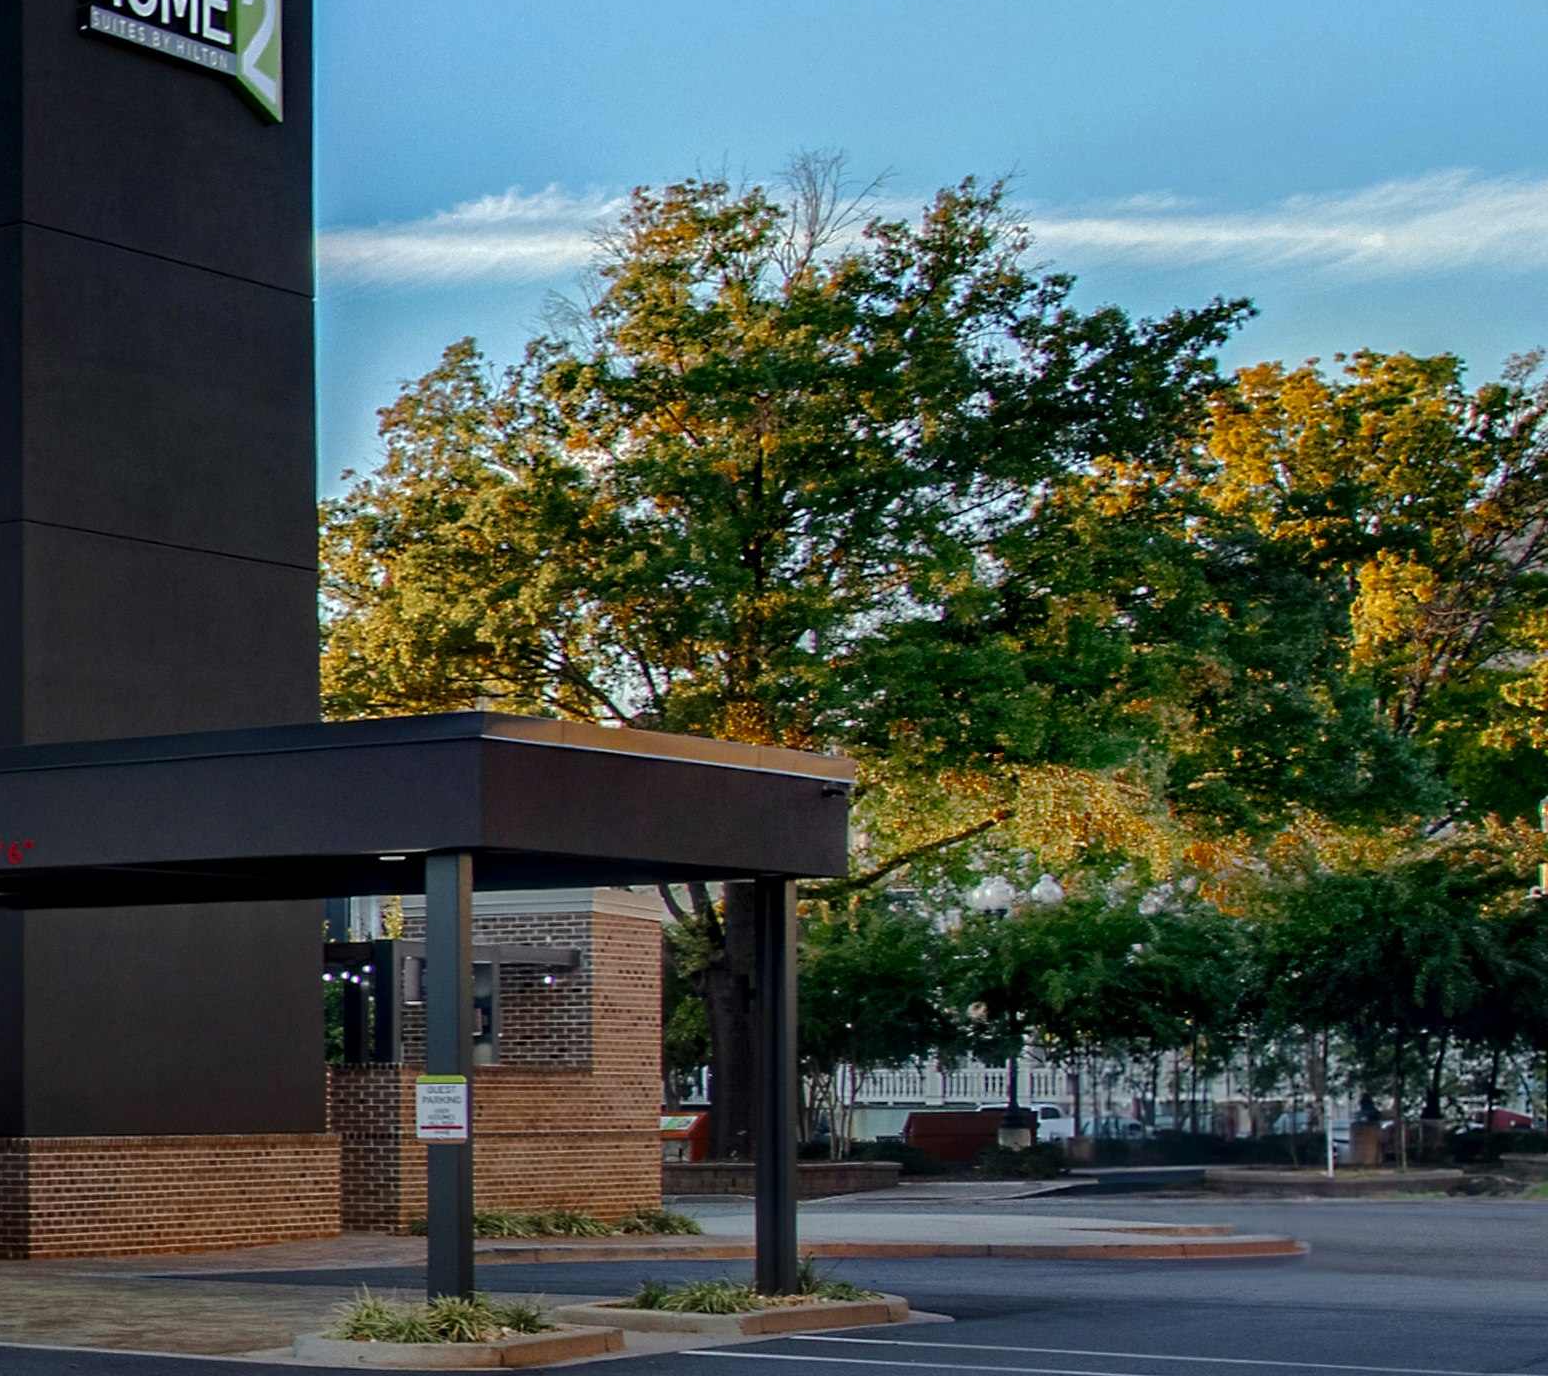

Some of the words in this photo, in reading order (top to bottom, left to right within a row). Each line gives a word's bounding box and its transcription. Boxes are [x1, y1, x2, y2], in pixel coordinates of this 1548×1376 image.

[91, 10, 145, 42] SUITES
[152, 31, 170, 49] BY
[176, 40, 228, 69] HILTON
[422, 1096, 461, 1104] PARKING
